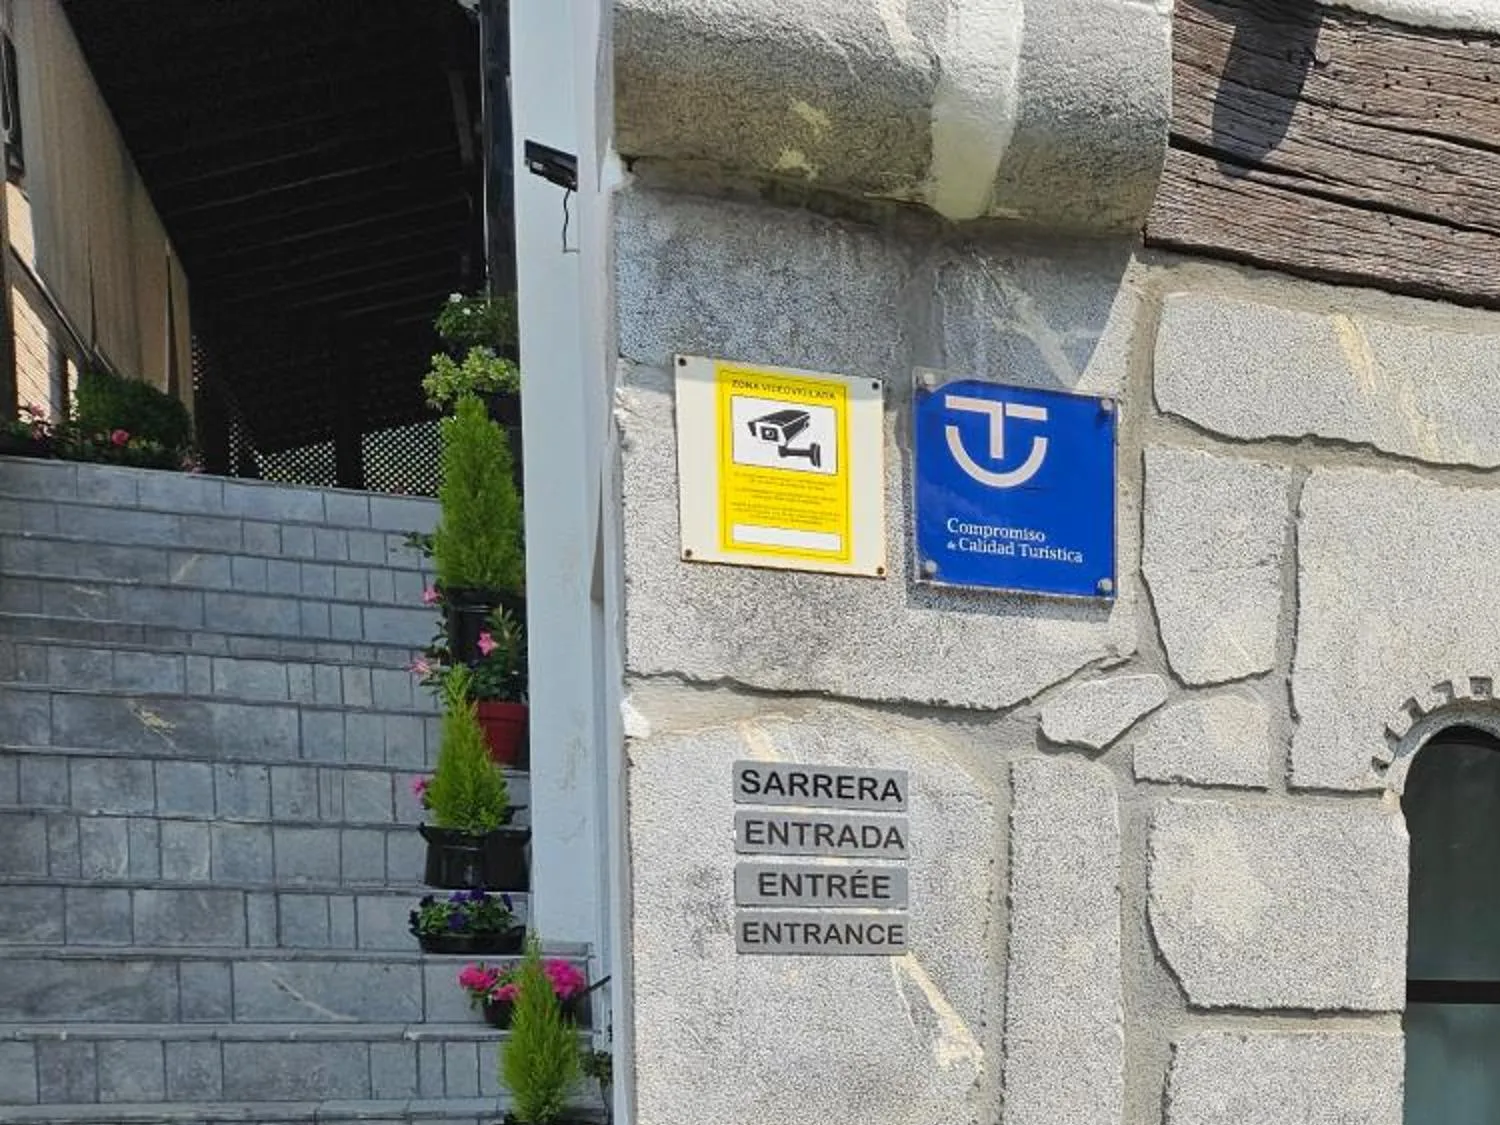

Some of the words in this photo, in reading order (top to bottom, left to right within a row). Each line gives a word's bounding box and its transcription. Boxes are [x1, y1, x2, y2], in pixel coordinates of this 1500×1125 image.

[731, 379, 760, 392] ZONA
[946, 517, 1046, 543] Compromiso
[958, 537, 1015, 556] Calidad
[740, 769, 902, 802] SARRERA
[745, 820, 905, 849] ENTRADA
[758, 870, 891, 899] ENTRÉE
[742, 921, 905, 945] ENTRANCE
